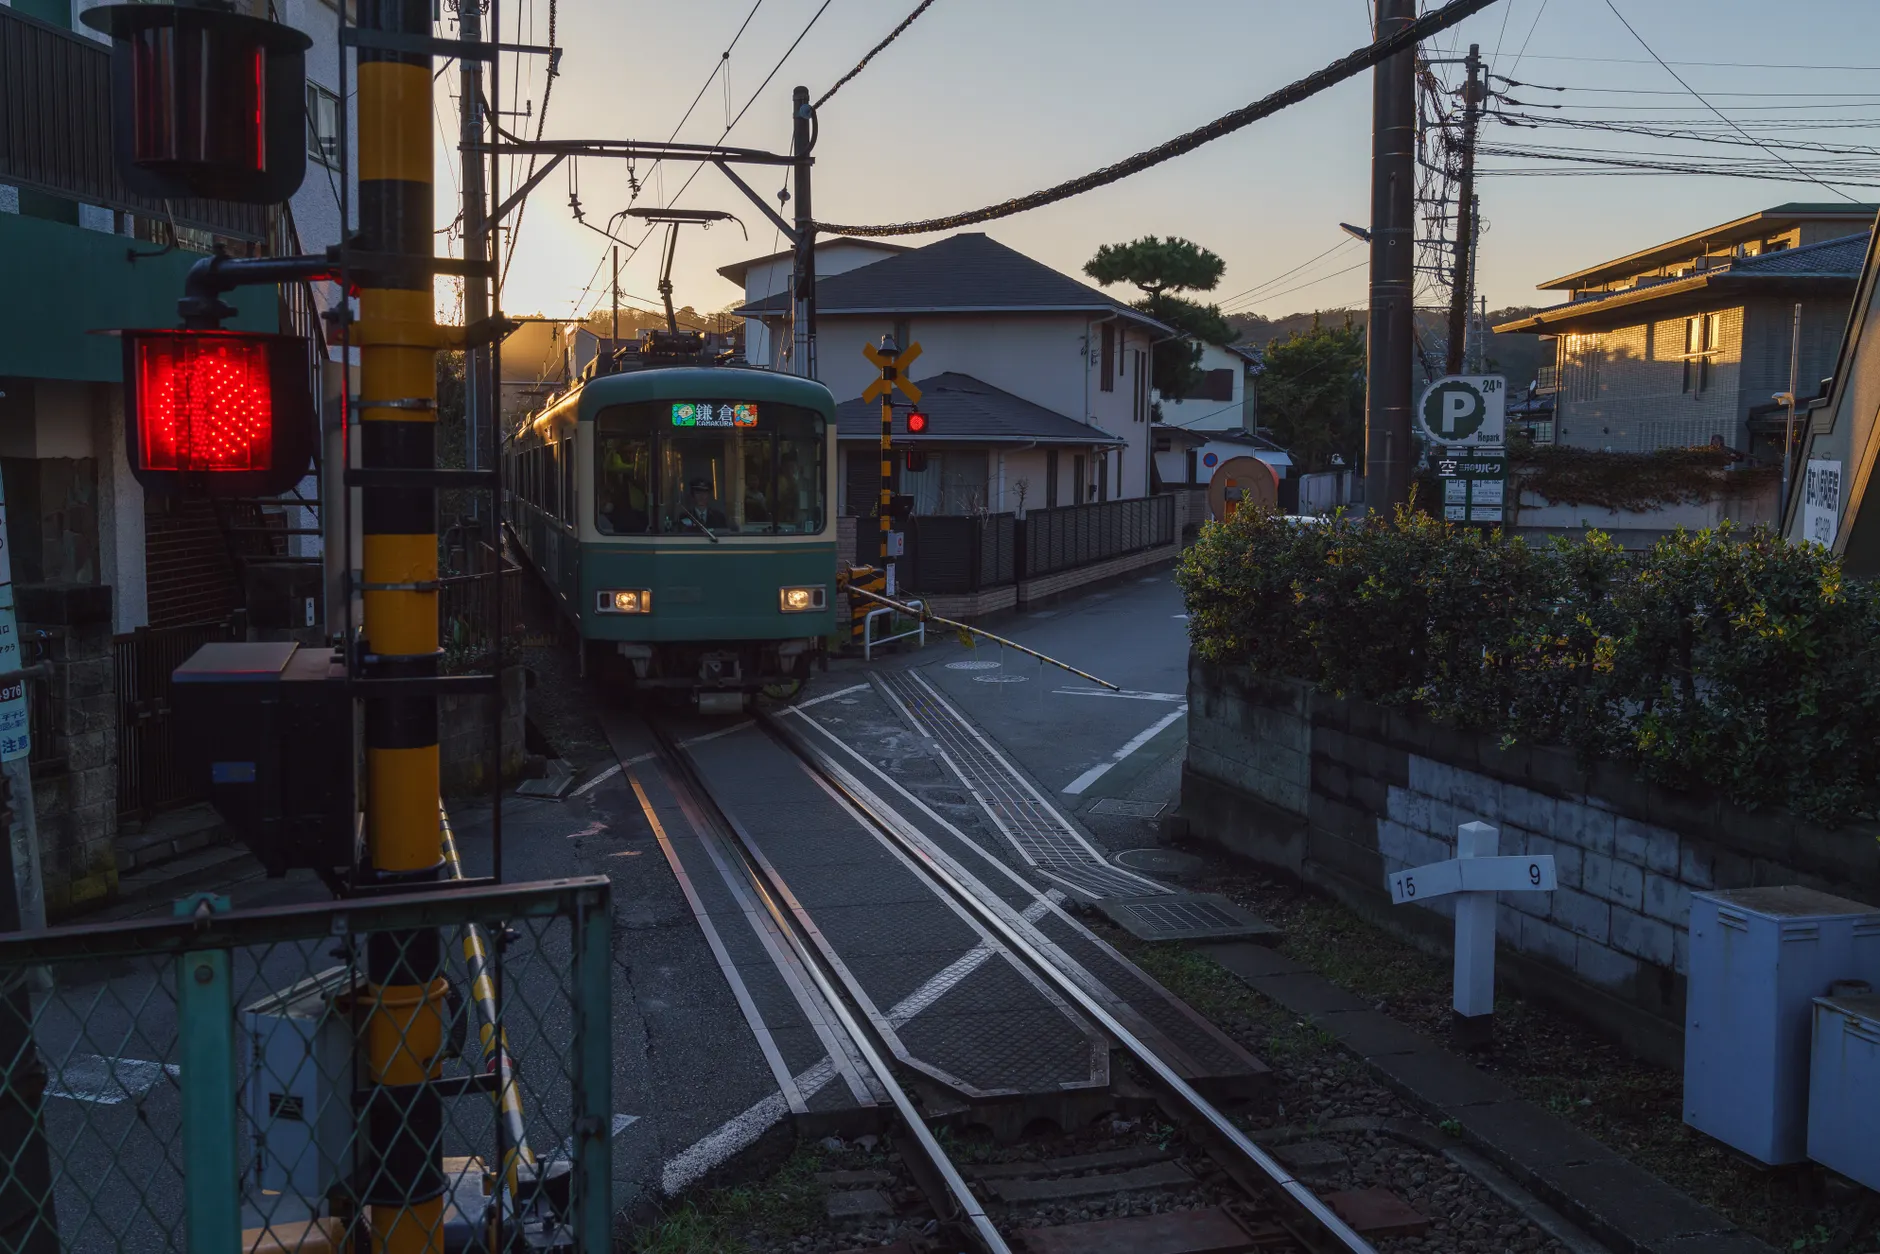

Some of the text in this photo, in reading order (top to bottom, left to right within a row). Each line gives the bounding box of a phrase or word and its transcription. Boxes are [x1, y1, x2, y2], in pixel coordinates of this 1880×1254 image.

[1482, 380, 1502, 393] 24h
[696, 403, 734, 421] 鎌倉
[1442, 391, 1476, 433] P
[1477, 430, 1500, 443] Repark
[1438, 459, 1457, 477] 空
[1529, 864, 1541, 885] 9
[1397, 877, 1416, 898] 15
